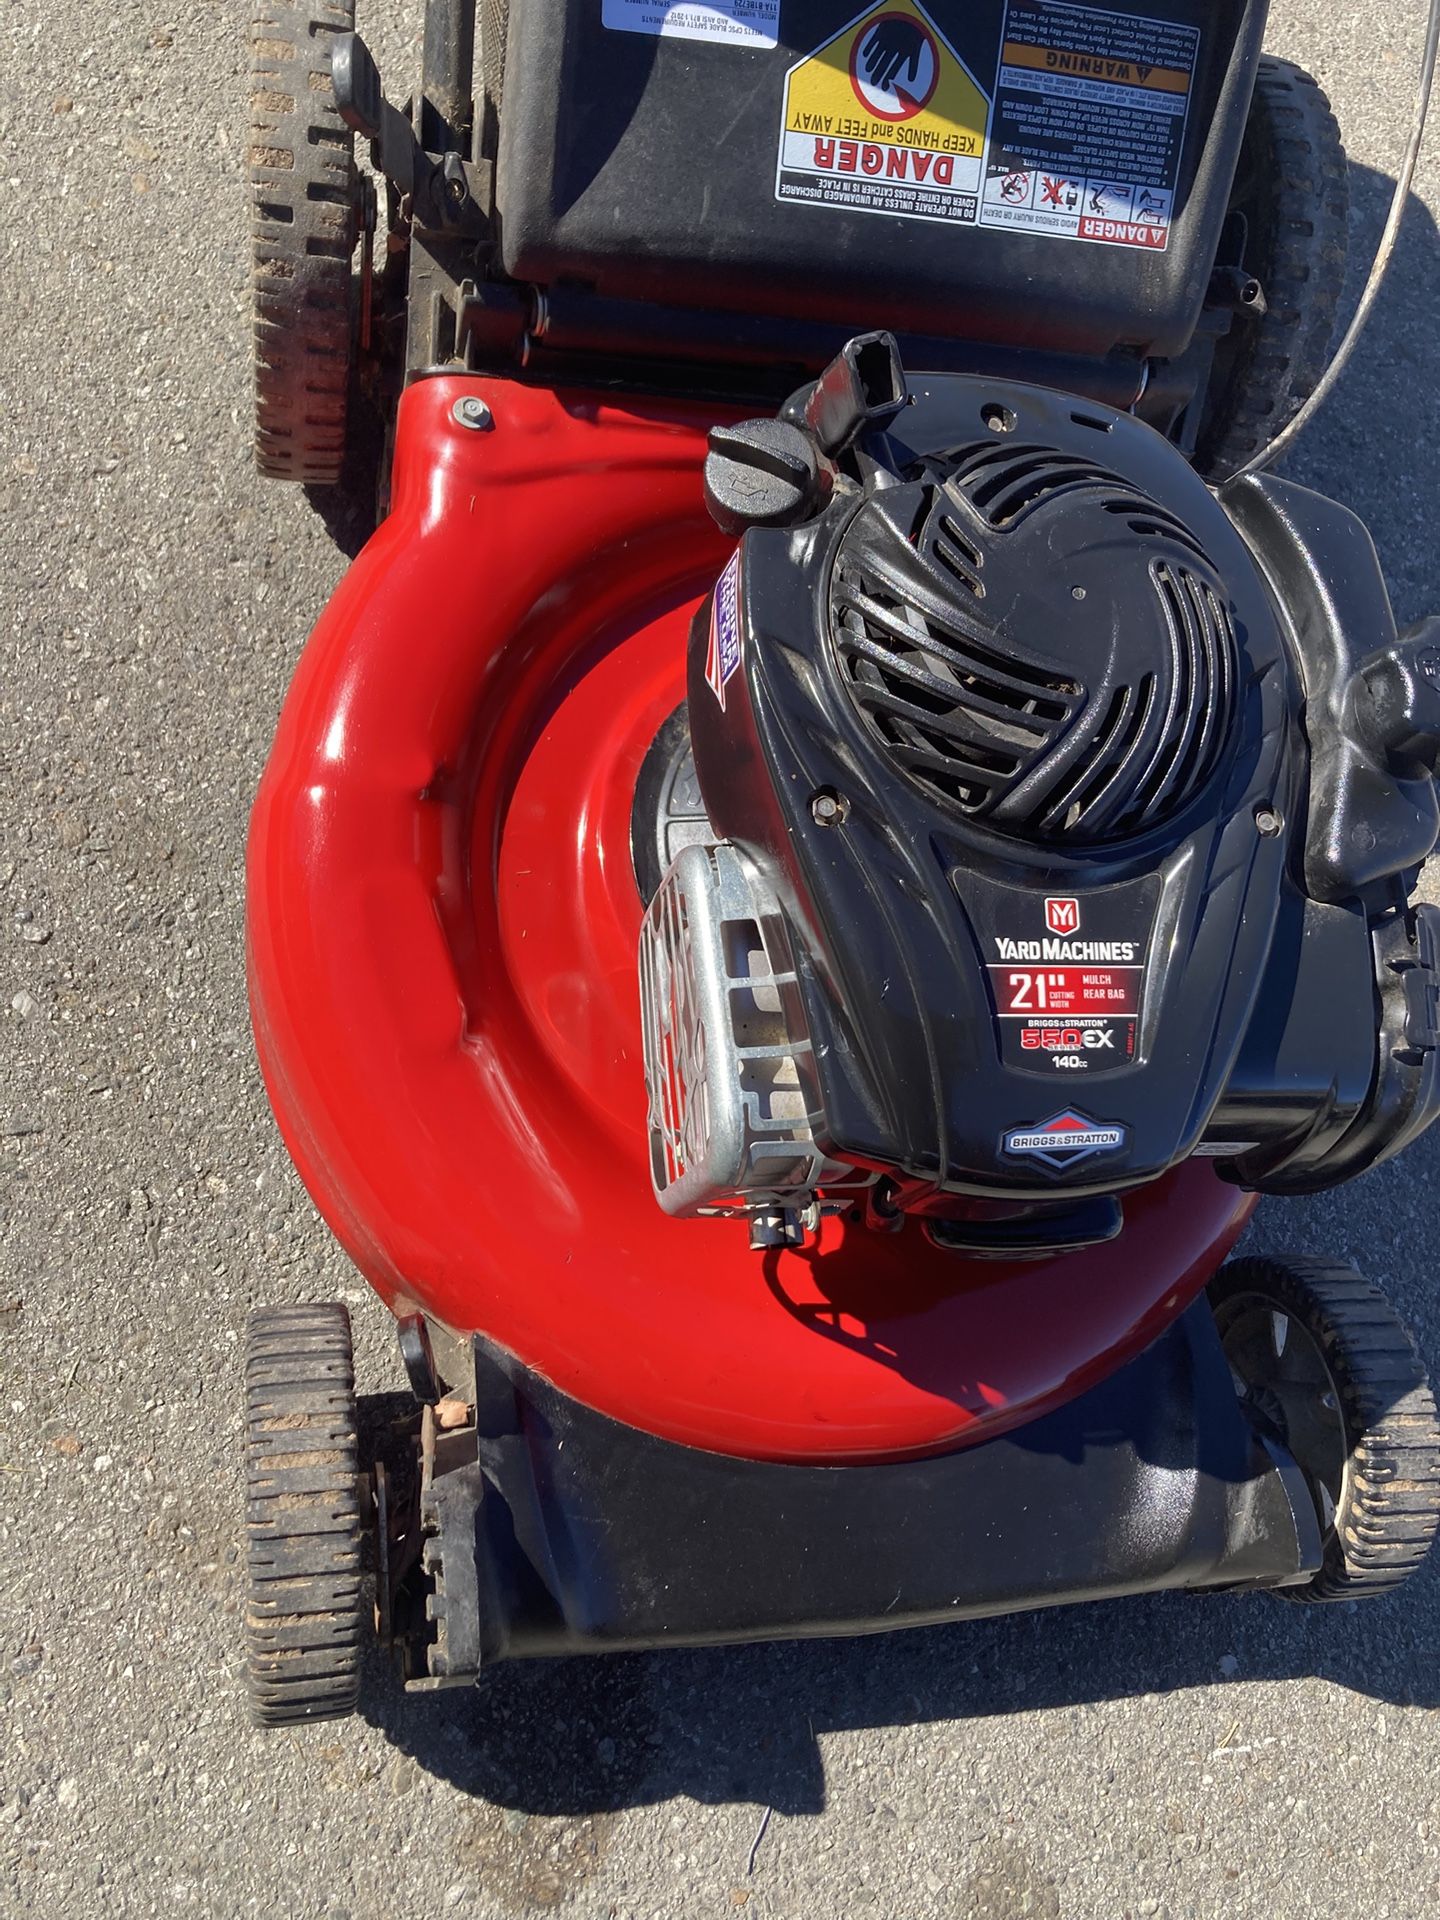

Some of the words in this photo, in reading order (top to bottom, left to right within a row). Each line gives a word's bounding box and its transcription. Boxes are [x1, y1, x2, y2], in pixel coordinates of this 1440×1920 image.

[687, 21, 707, 29] SAFETY
[1045, 51, 1131, 78] WARNING
[792, 111, 832, 133] AWAY
[835, 117, 867, 137] FEET
[871, 122, 893, 141] and
[895, 126, 939, 147] HANDS
[942, 133, 975, 152] KEEP
[812, 137, 954, 185] DANGER
[815, 177, 841, 190] PLACE.
[842, 181, 850, 191] IN
[852, 183, 860, 192] IS
[781, 184, 822, 198] DISCHARGE
[861, 184, 893, 196] CATCHER
[893, 188, 915, 199] GRASS
[823, 189, 870, 204] UNDAMAGED
[872, 196, 883, 206] AN
[917, 191, 939, 203] ENTIRE
[941, 195, 951, 204] OR
[952, 196, 975, 207] COVER
[884, 198, 913, 210] UNLESS
[914, 202, 946, 214] OPERATE
[947, 206, 962, 216] NOT
[963, 208, 974, 218] DO
[983, 207, 1002, 218] DEATH
[1002, 210, 1011, 219] OR
[1011, 211, 1033, 222] INJURY
[1034, 215, 1059, 226] SERIOUS
[1060, 218, 1077, 228] AVOID
[1083, 218, 1147, 241] DANGER
[730, 558, 738, 662] ENGINE
[994, 937, 1040, 959] YARD
[1082, 975, 1111, 984] MULCH
[1009, 974, 1064, 1007] 21"
[1049, 991, 1074, 999] CUTTING
[1083, 989, 1105, 998] REAR
[1107, 989, 1124, 998] BAG
[1020, 1028, 1114, 1049] 550EX
[1052, 1055, 1087, 1067] 140cc
